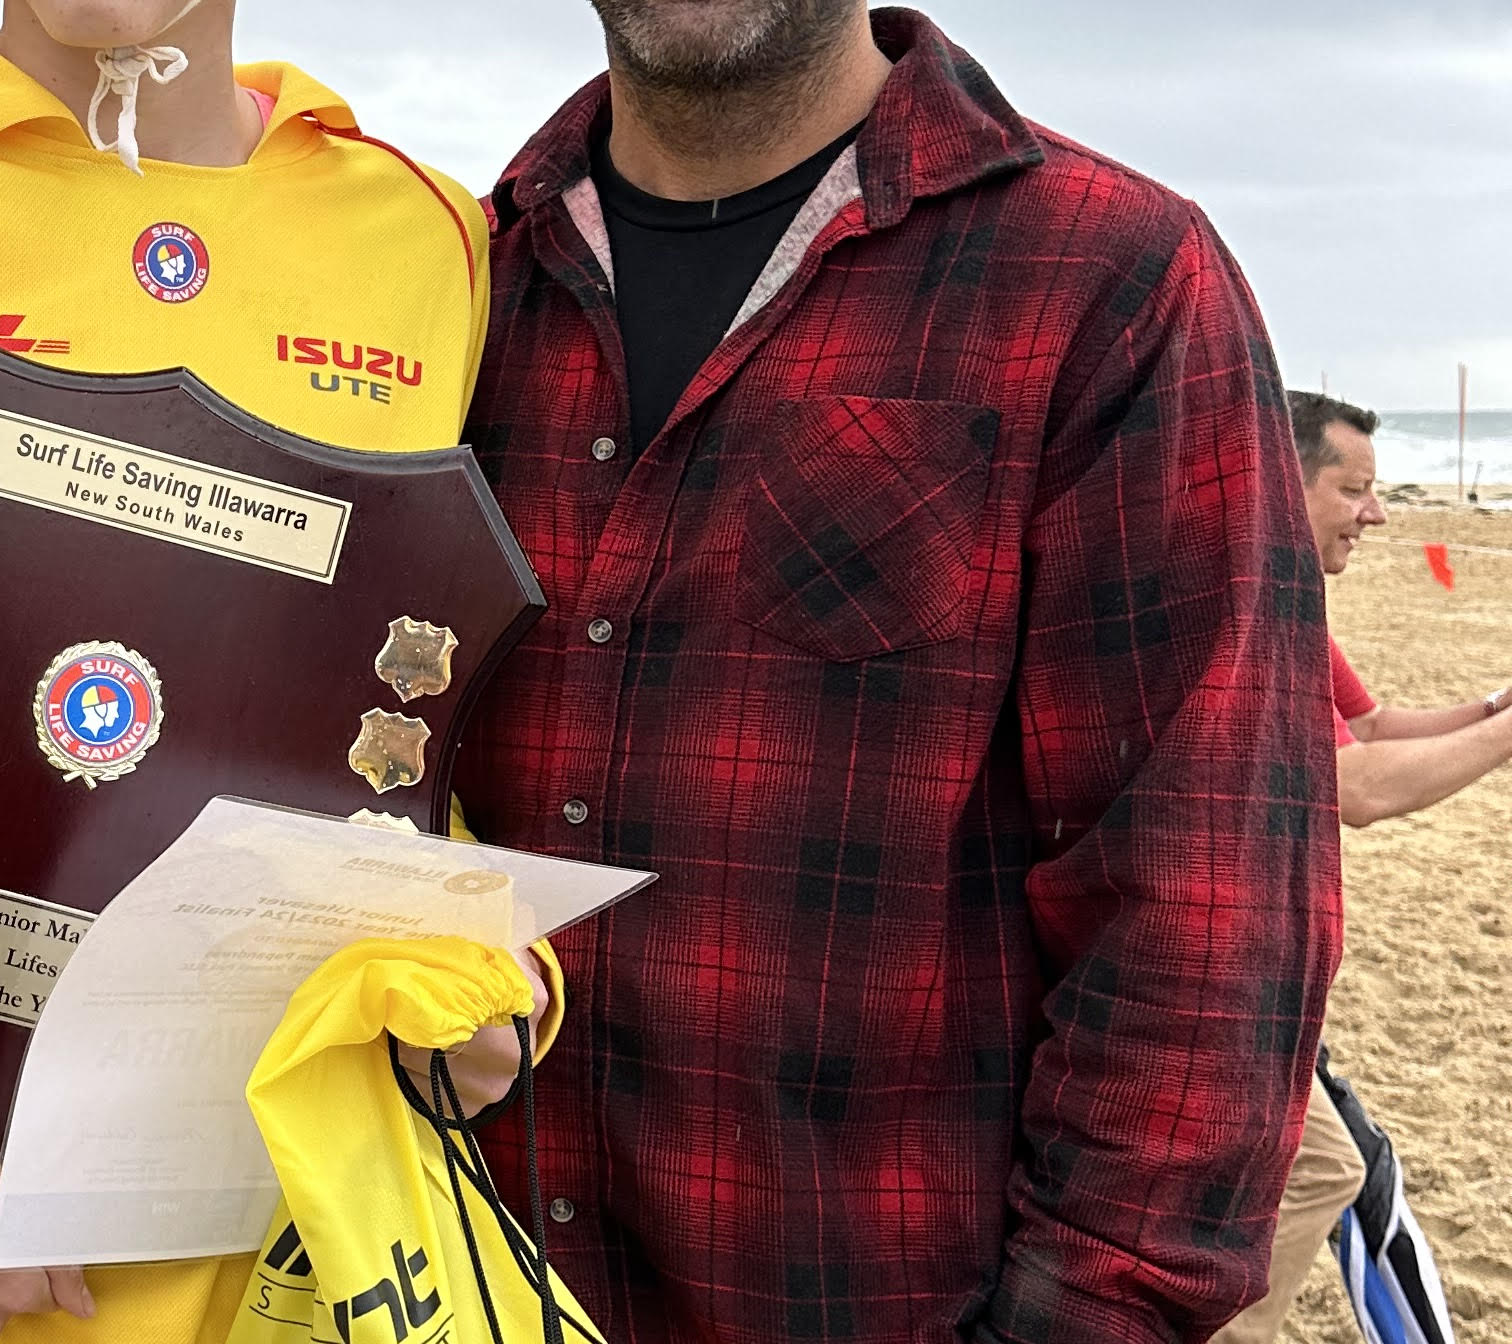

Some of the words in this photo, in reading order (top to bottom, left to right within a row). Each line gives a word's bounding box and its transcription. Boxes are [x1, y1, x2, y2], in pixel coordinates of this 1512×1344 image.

[150, 224, 197, 244] SURF
[135, 261, 159, 296] LIFE
[161, 267, 208, 302] SAVING
[276, 334, 423, 387] ISUZU
[309, 371, 393, 406] UTE
[15, 432, 68, 467] Surf
[71, 447, 117, 480] Life
[121, 461, 203, 508] Saving
[207, 483, 309, 532] Illawarra
[64, 480, 109, 506] New
[114, 494, 176, 525] South
[183, 513, 245, 543] Wales
[79, 659, 139, 687] SURF
[48, 703, 75, 748] LIFE
[76, 721, 147, 761] SAVING
[44, 918, 87, 946] Ma
[4, 947, 59, 978] Lifes
